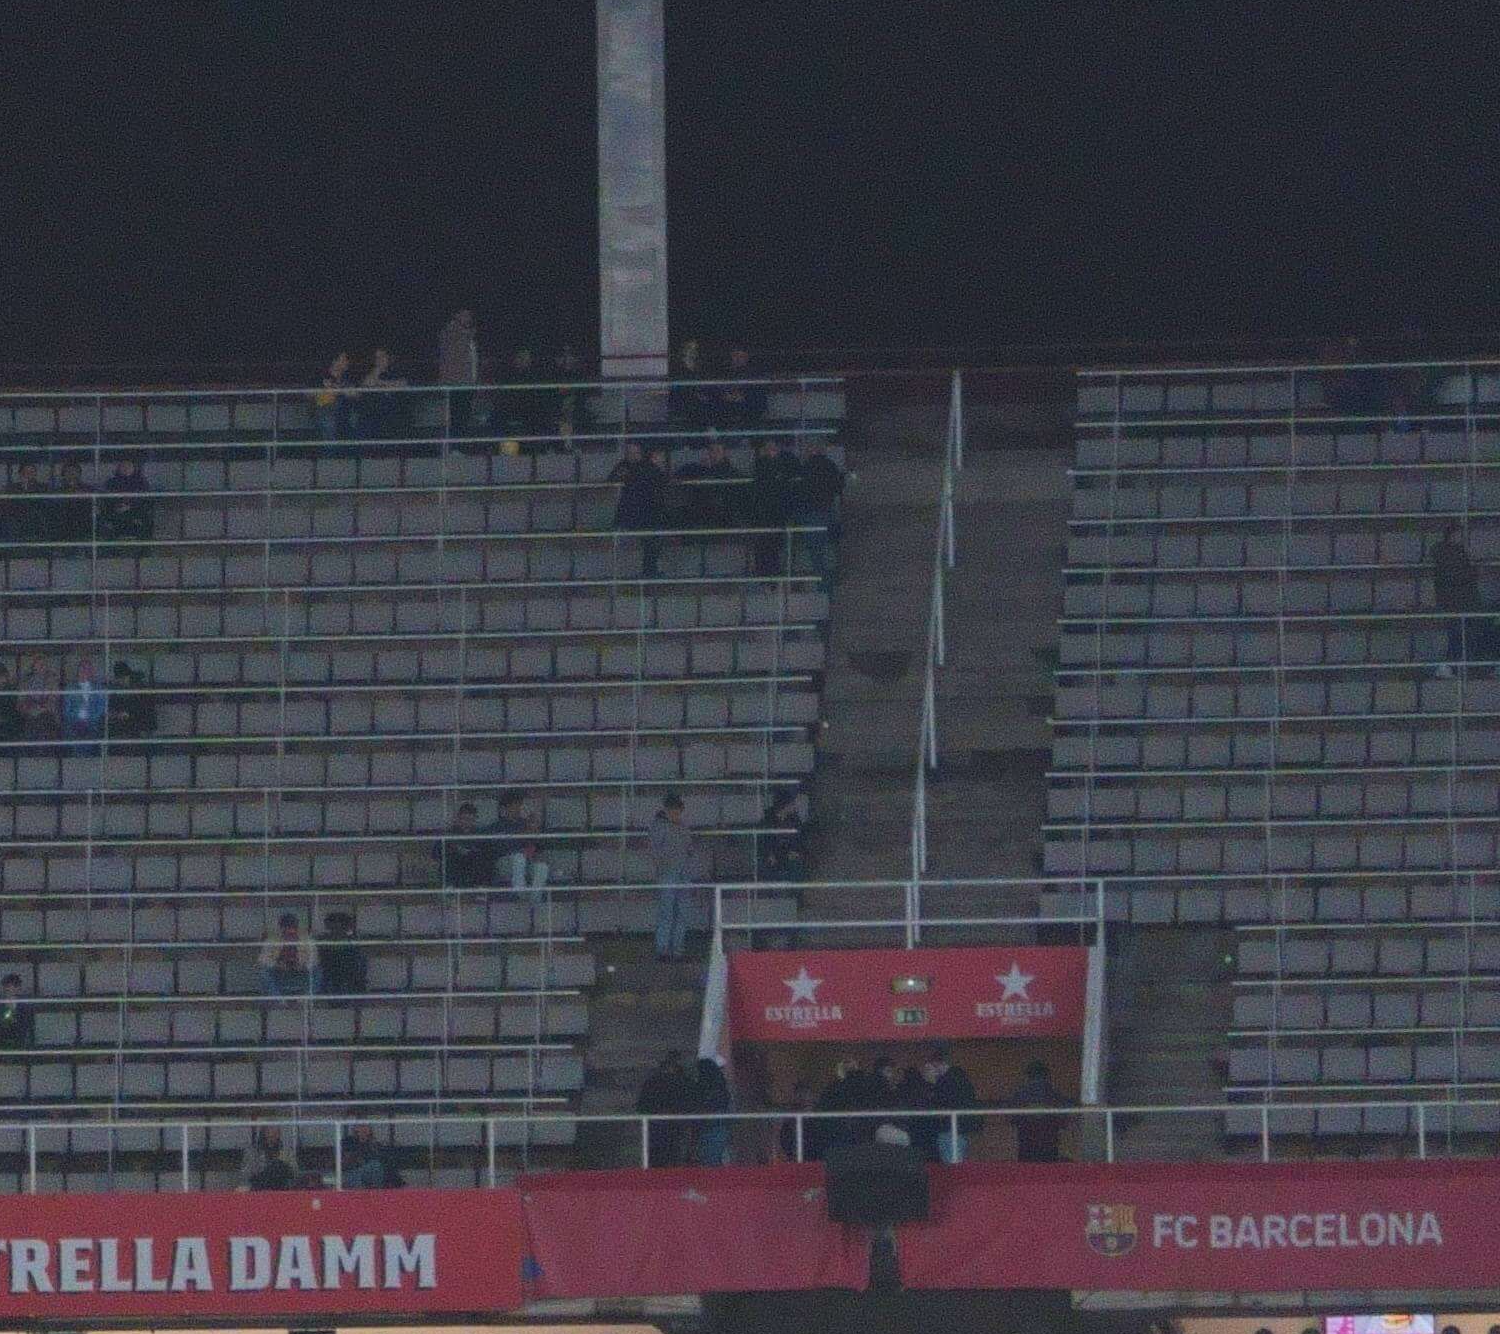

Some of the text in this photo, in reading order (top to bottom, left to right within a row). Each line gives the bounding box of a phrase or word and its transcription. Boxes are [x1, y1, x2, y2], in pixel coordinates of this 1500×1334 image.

[764, 1006, 843, 1020] ESTRELLA
[1153, 1212, 1444, 1249] FC BARCELONA
[230, 1234, 438, 1291] DAMM
